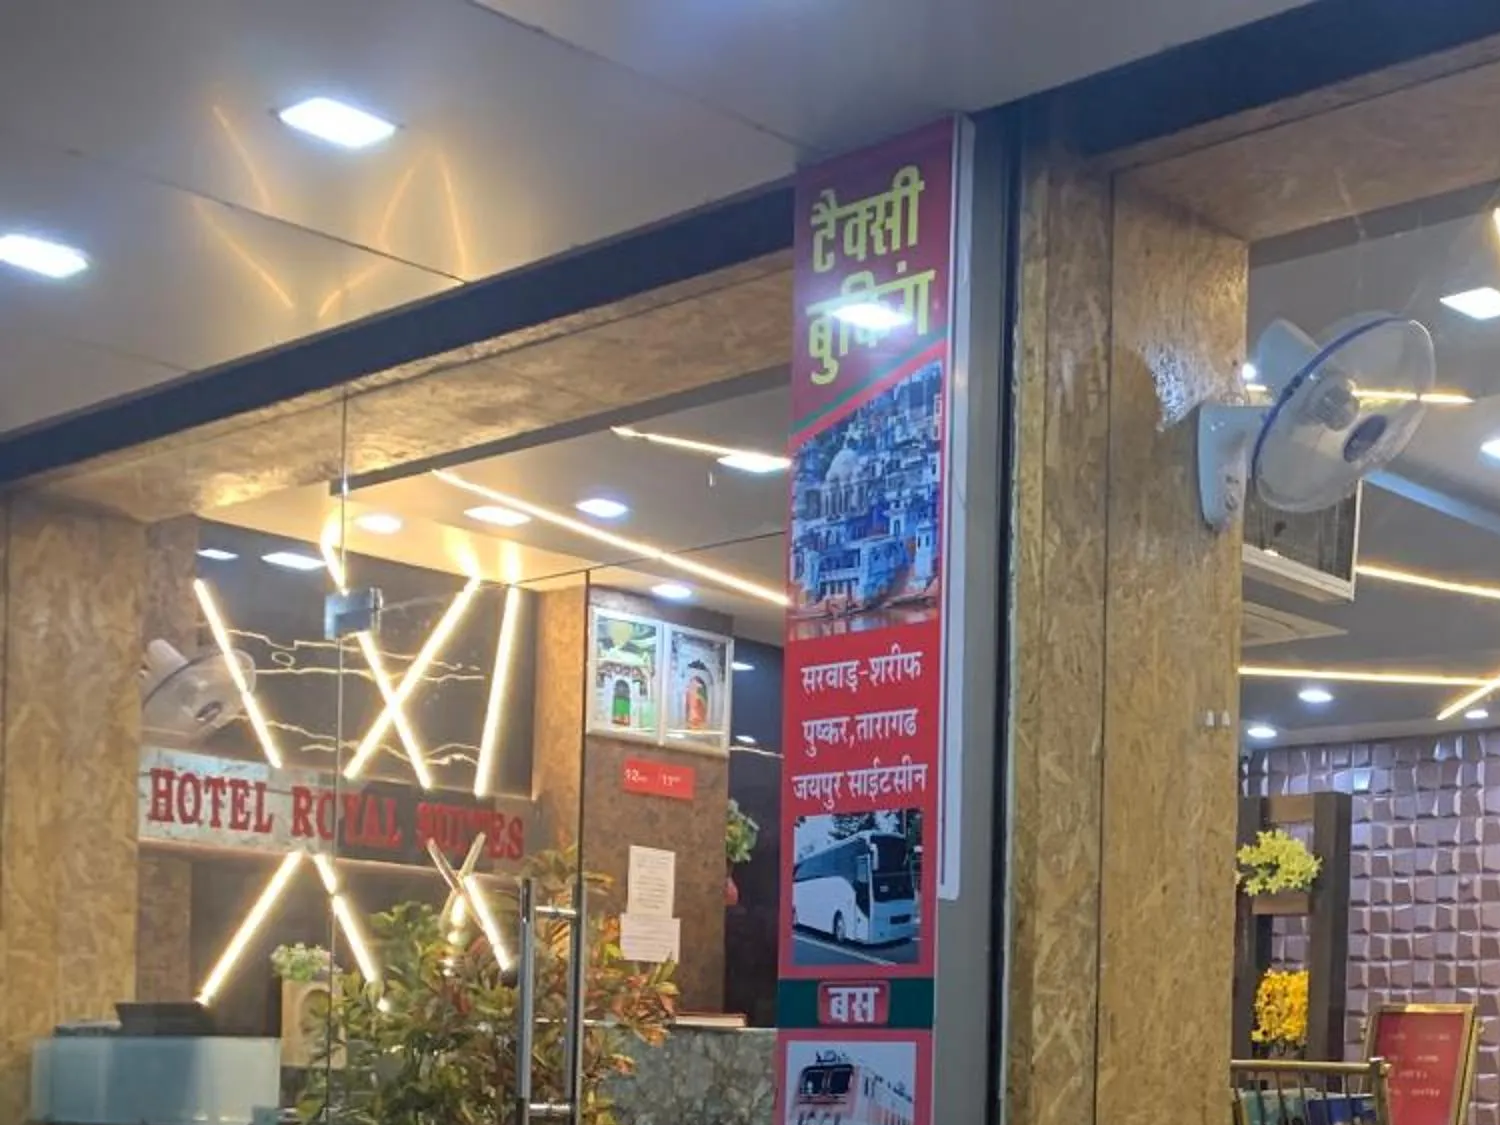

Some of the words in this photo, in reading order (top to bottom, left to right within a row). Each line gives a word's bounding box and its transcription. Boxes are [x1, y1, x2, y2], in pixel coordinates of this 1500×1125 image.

[810, 165, 925, 273] टैक्सी
[148, 767, 273, 834] HOTEL
[291, 785, 403, 849] ROYAL
[791, 772, 844, 811] जयपुर
[827, 987, 880, 1022] बस
